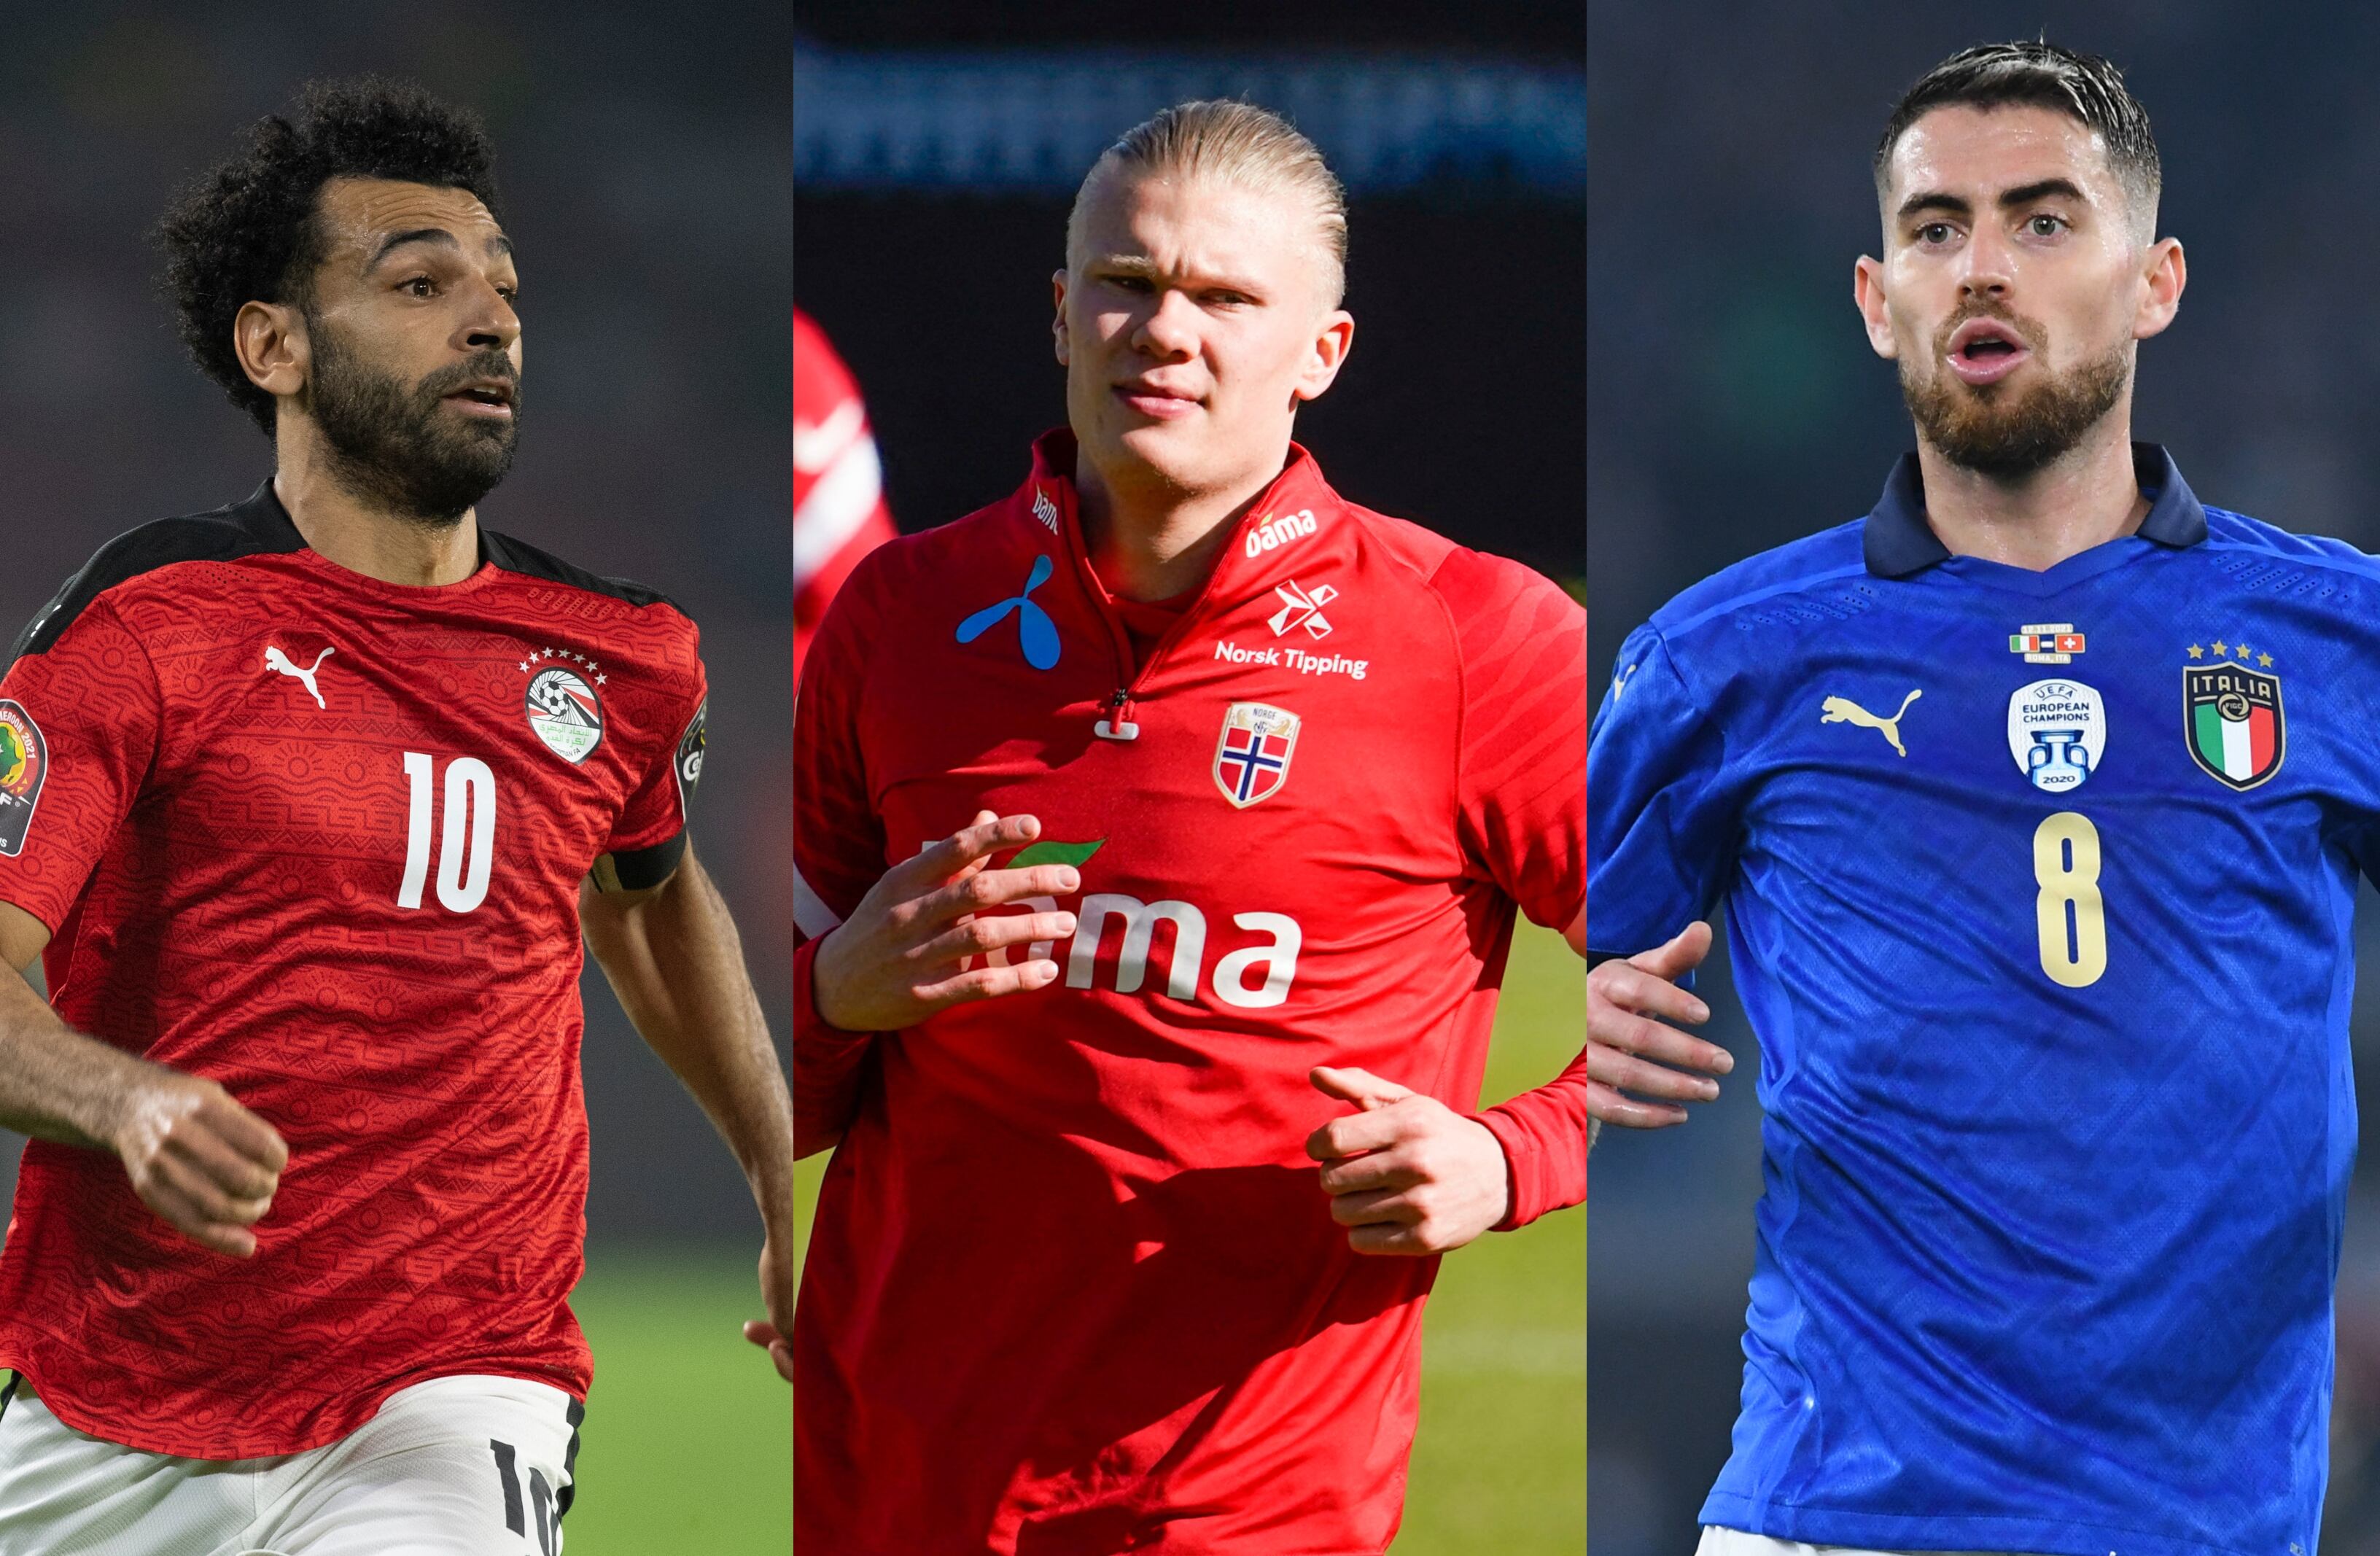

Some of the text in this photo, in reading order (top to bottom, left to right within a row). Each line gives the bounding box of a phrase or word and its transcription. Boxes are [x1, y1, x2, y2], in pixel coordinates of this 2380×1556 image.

[1214, 641, 1369, 680] Norsk Tipping
[2036, 685, 2074, 699] UEFA
[2193, 675, 2271, 699] ITALIA
[1253, 708, 1277, 720] NORGE
[2023, 702, 2090, 713] EUROPEAN
[2023, 713, 2090, 723] CHAMPIONS
[21, 732, 36, 759] 2021
[573, 747, 581, 755] FA
[2042, 775, 2076, 784] 2020
[397, 751, 497, 913] 10
[2032, 811, 2108, 989] 8
